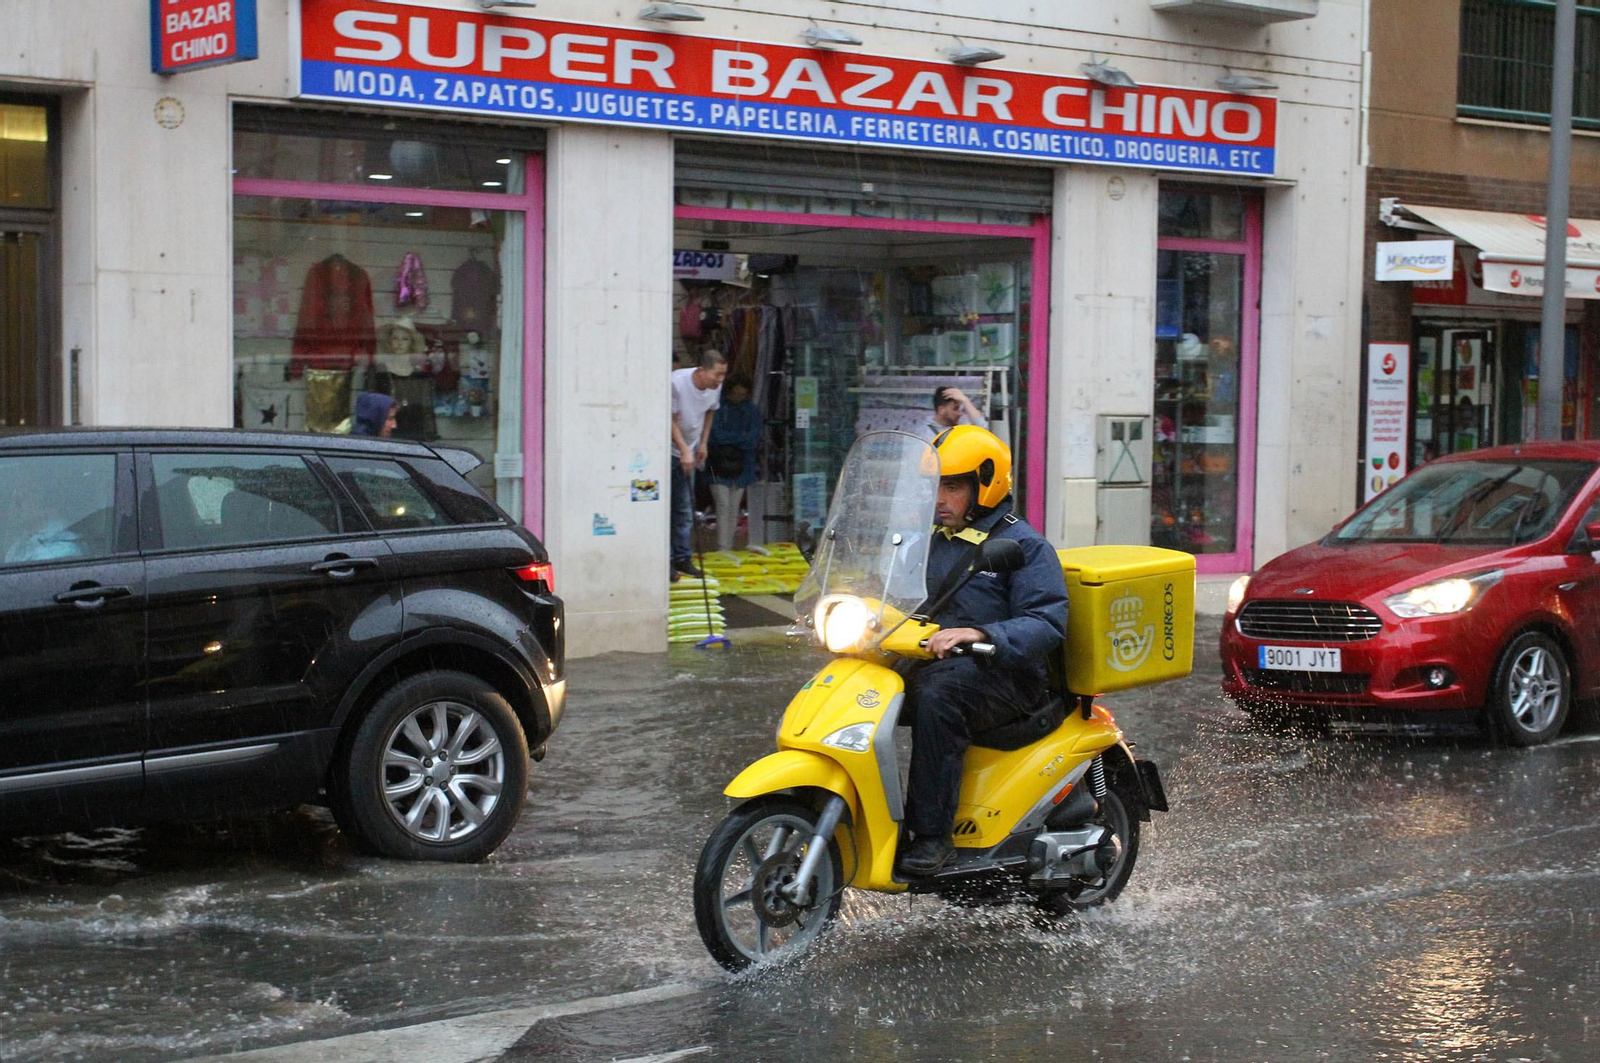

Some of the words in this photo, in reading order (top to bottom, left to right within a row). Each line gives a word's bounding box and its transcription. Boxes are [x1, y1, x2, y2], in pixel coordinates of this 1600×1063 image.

[166, 2, 231, 34] BAZAR
[171, 33, 227, 62] CHINO
[333, 10, 676, 89] SUPER
[712, 49, 1013, 120] BAZAR
[1042, 86, 1262, 142] CHINO
[334, 69, 425, 101] MODA,
[433, 78, 563, 113] ZAPATOS,
[571, 91, 703, 124] JUGUETES,
[710, 103, 844, 137] PAPELERIA,
[851, 116, 988, 148] FERRETERIA,
[1229, 149, 1261, 169] ETC
[1387, 254, 1447, 265] Moneytrans
[1163, 582, 1174, 661] CORREOS
[1267, 649, 1301, 666] 9001
[1308, 651, 1336, 668] JYT
